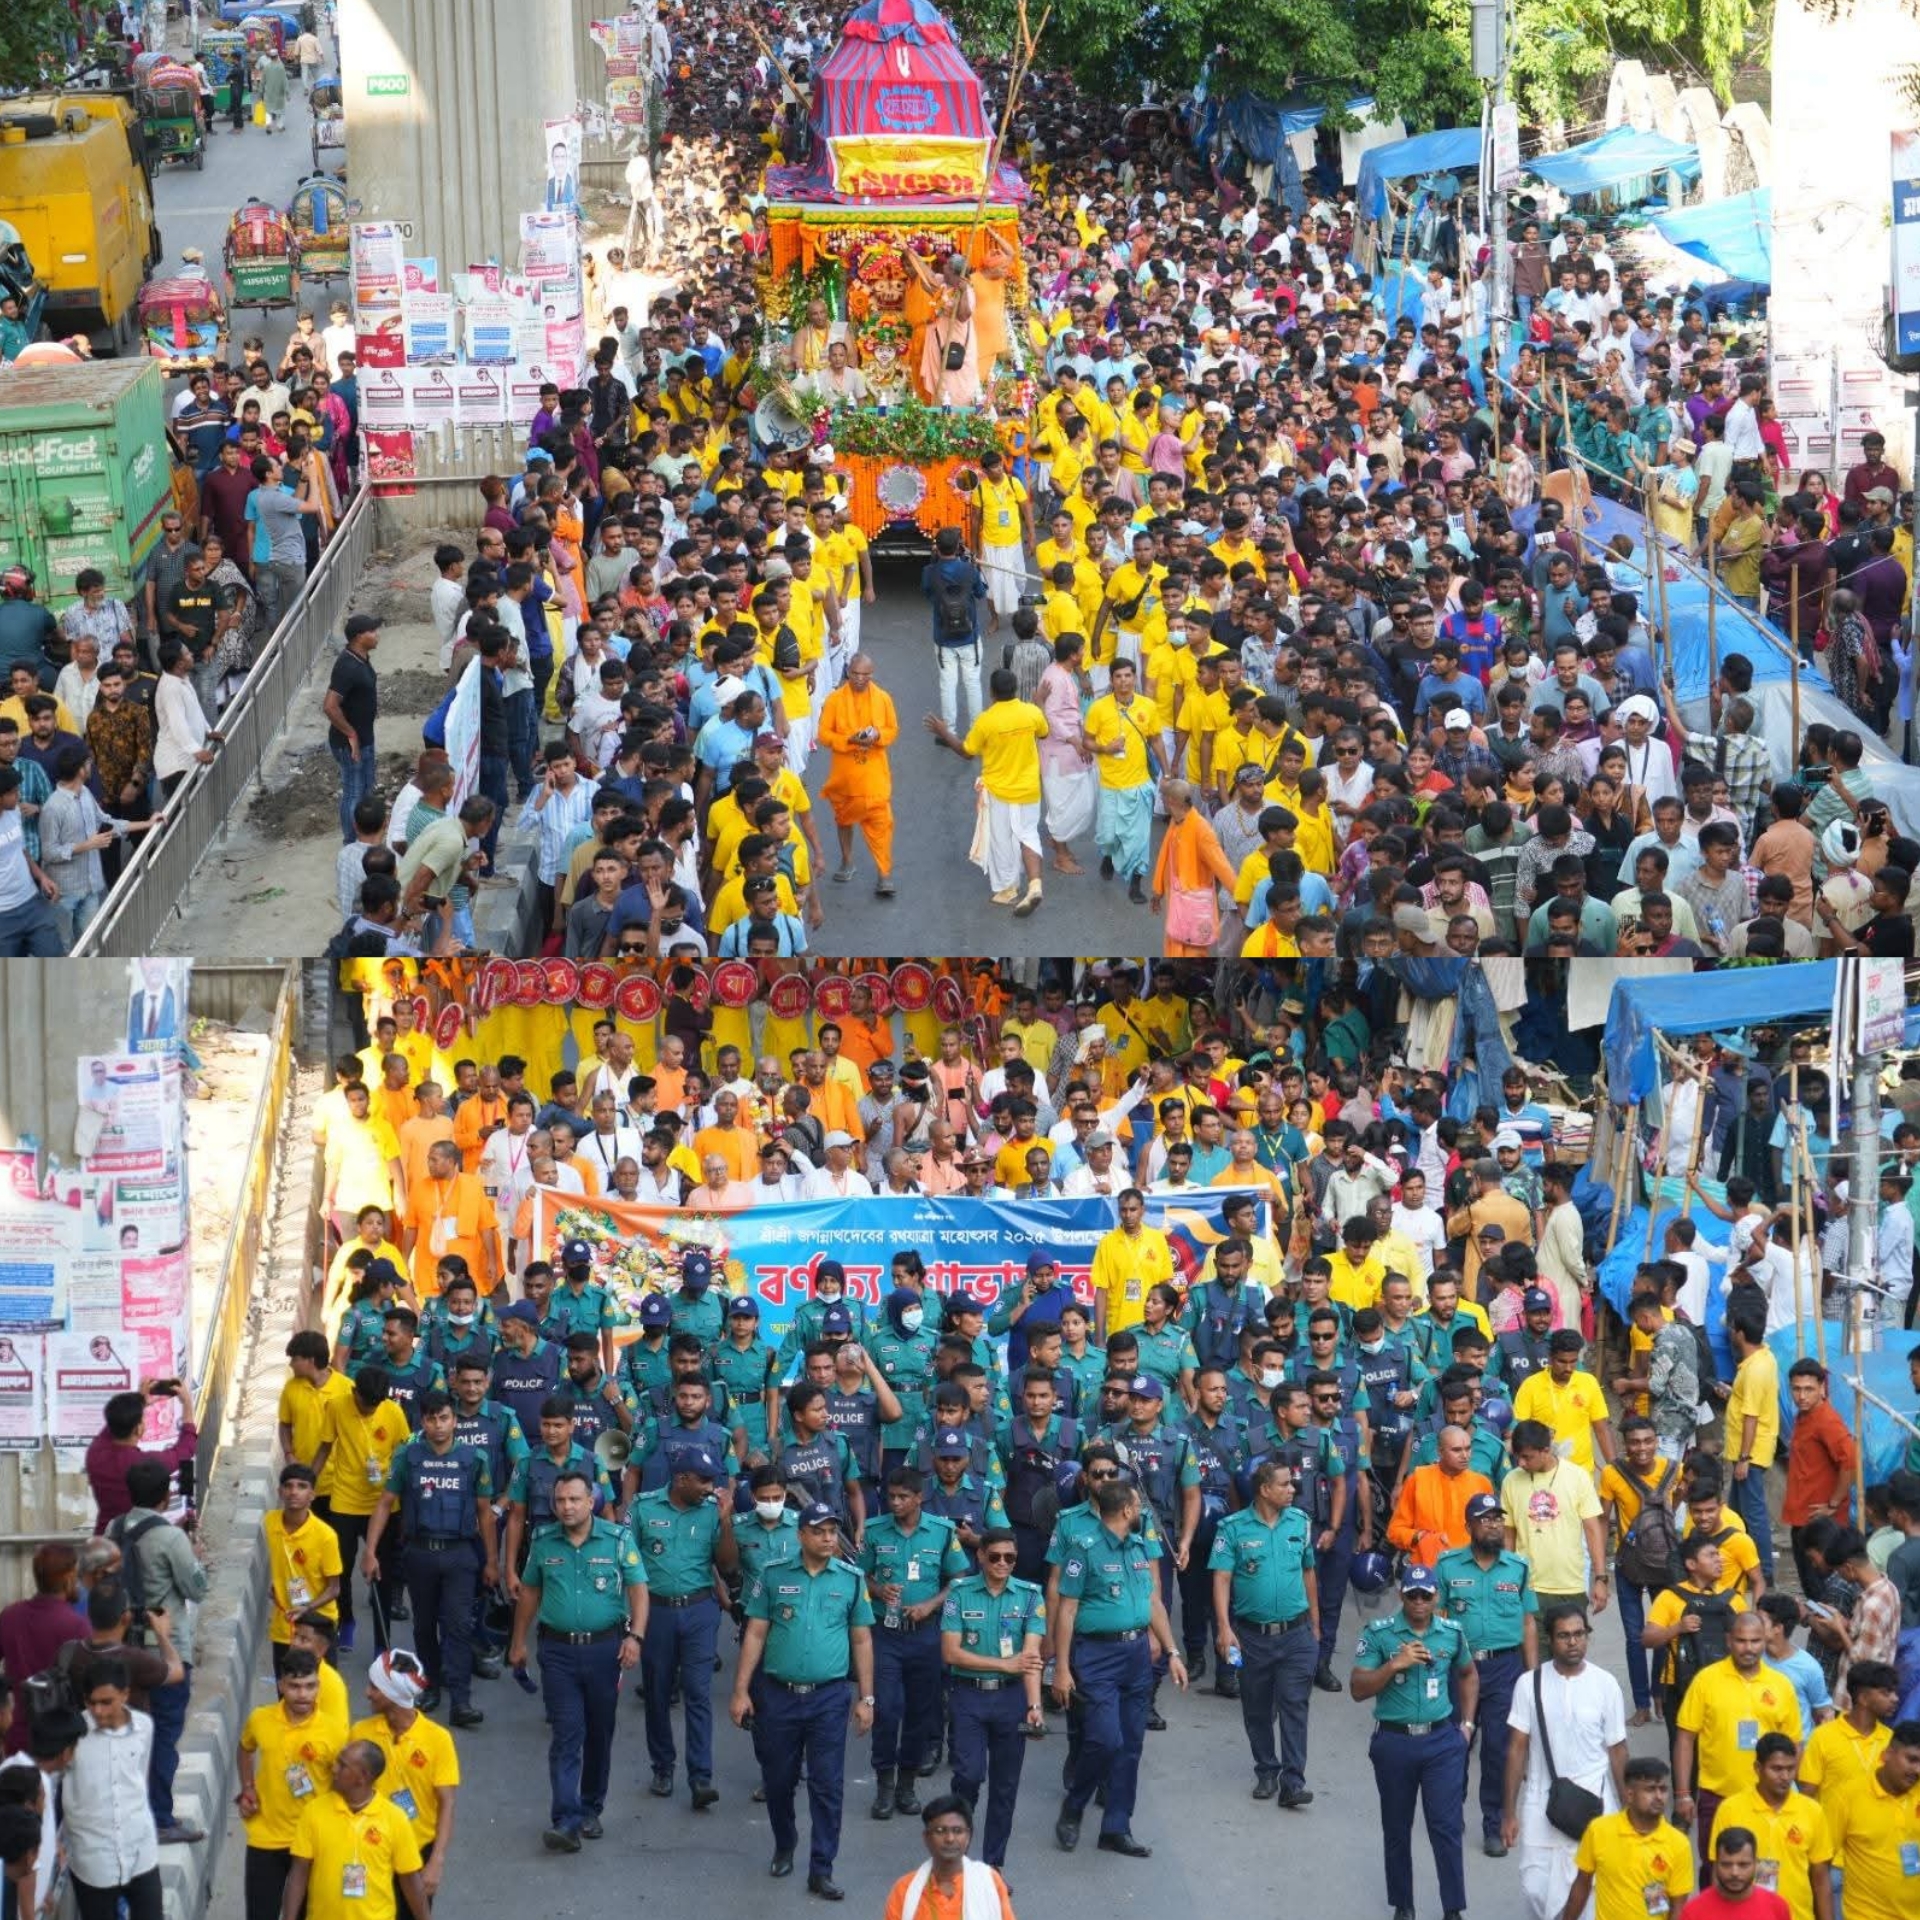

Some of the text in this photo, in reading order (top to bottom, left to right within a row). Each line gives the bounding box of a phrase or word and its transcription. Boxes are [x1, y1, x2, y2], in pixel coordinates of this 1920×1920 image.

[368, 79, 405, 91] P600
[36, 464, 81, 475] Courier
[760, 1225, 791, 1244] শ্রীশ্রী
[797, 1228, 884, 1244] জগন্নাথদেবের
[888, 1228, 934, 1244] রথযাত্রা
[939, 1228, 999, 1244] মহোৎসব
[1004, 1229, 1044, 1245] ২০২৫
[755, 1251, 884, 1306] বর্ণঢ্য
[1363, 1369, 1399, 1382] OLICE
[504, 1378, 544, 1389] POLICE
[826, 1411, 865, 1424] POLICE
[791, 1457, 831, 1475] POLICE
